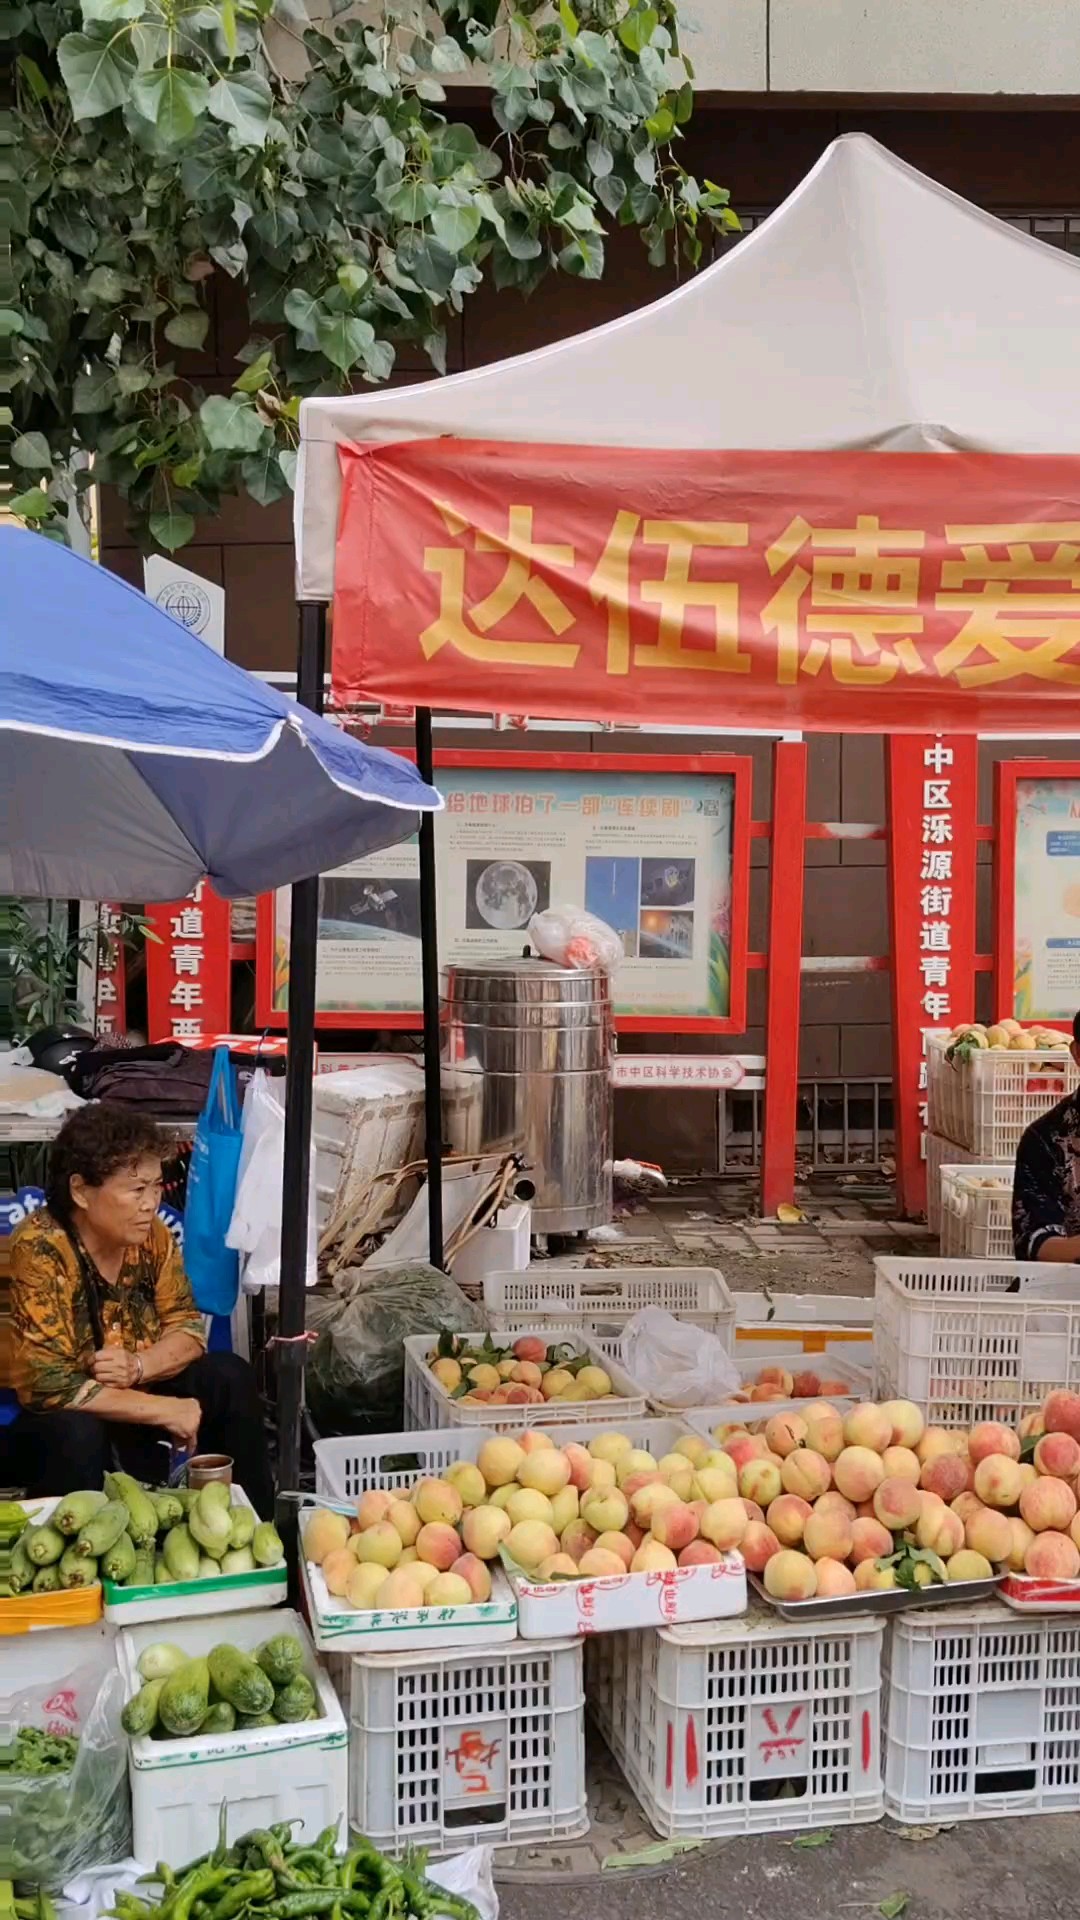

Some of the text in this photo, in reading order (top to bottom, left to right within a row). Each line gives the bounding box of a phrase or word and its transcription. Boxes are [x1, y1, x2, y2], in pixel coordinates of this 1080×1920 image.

[419, 500, 1080, 689] 达伍德爱
[918, 735, 954, 1162] 中区泺源街道青年
[616, 1066, 733, 1079] 市中区科学技术协会
